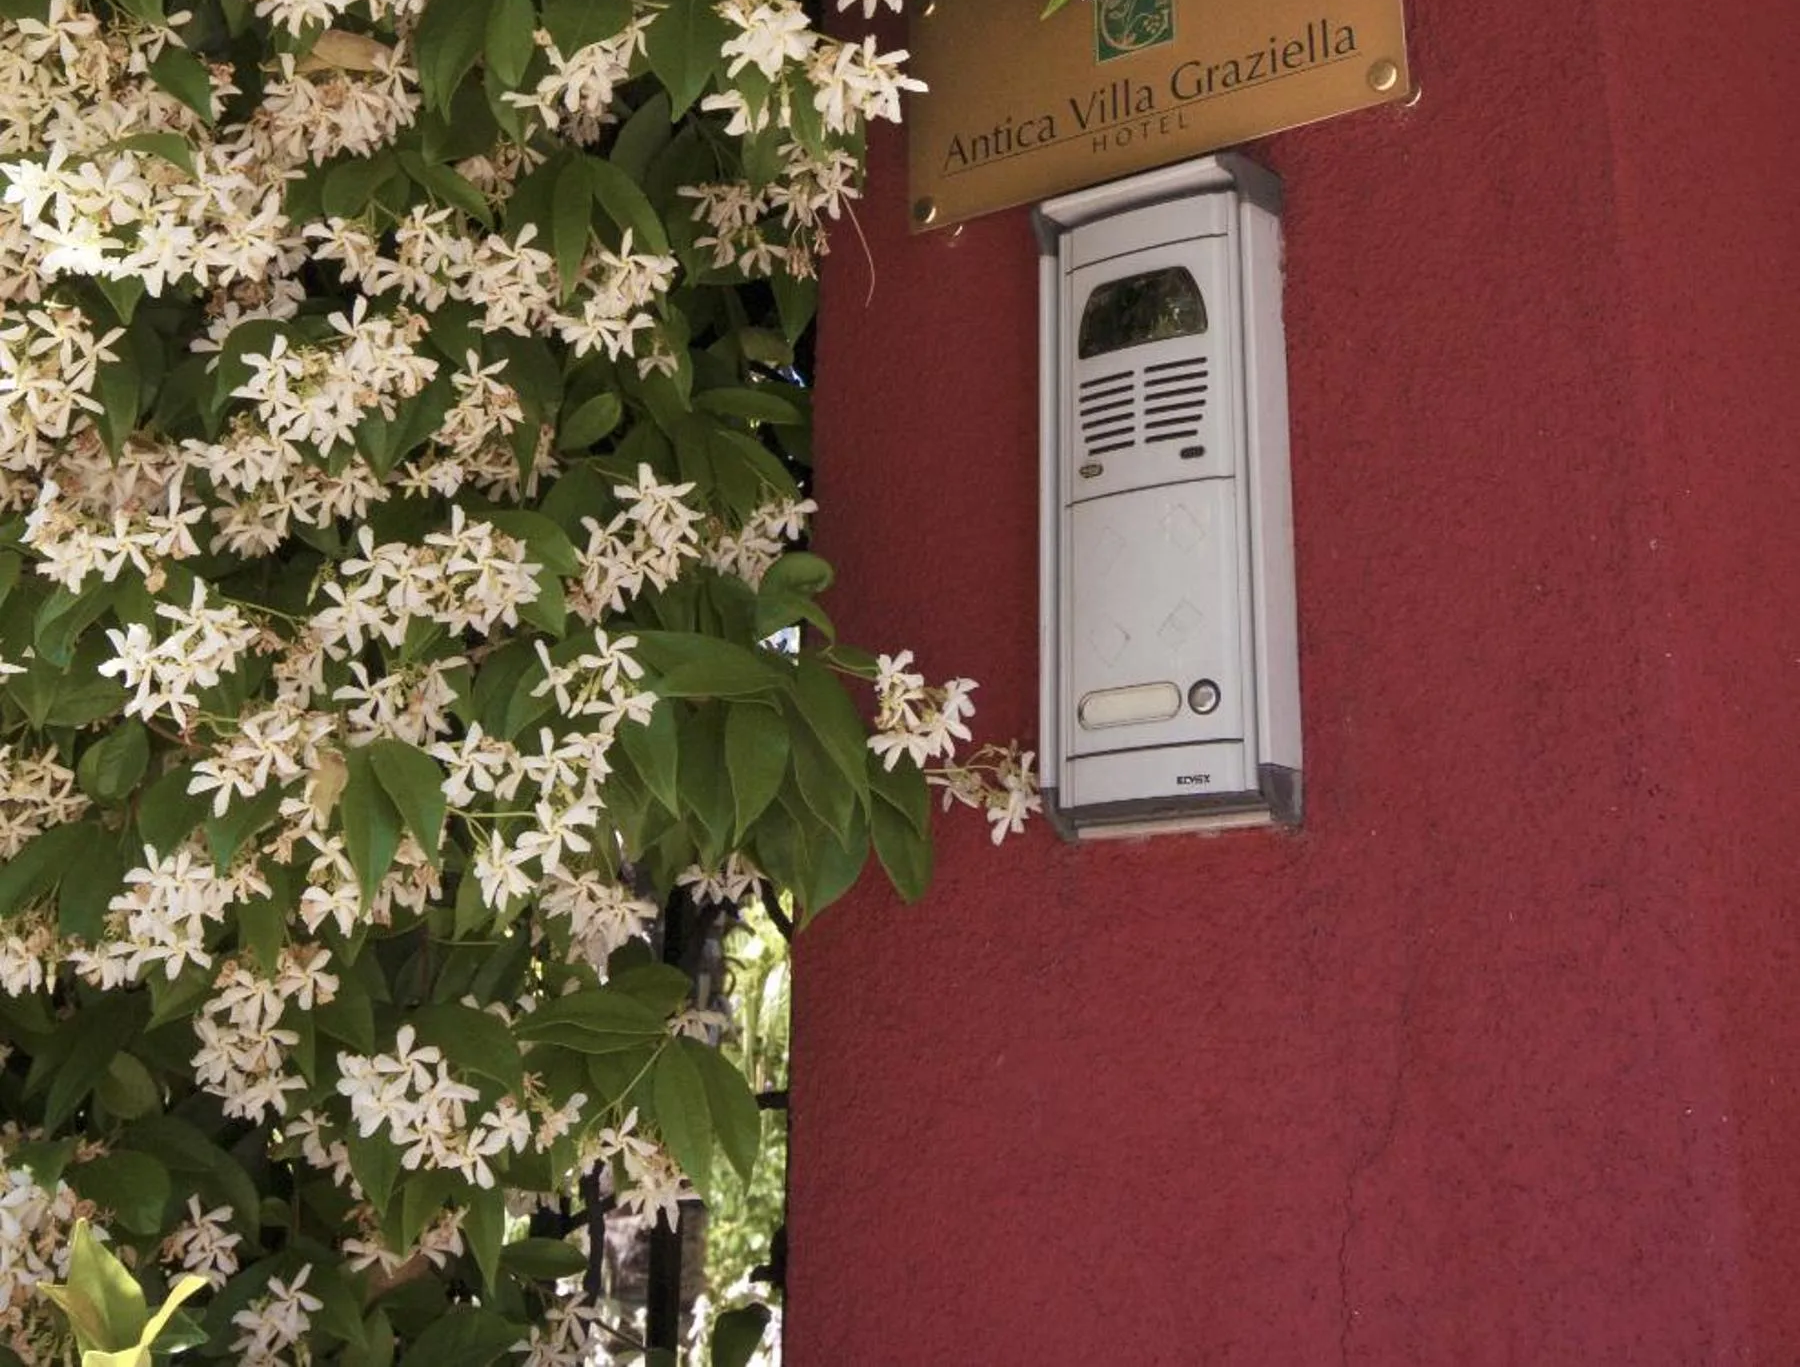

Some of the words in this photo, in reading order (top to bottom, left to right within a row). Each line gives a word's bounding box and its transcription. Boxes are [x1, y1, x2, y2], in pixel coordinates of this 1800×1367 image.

[943, 114, 1057, 171] Antica
[1069, 78, 1155, 130] Villa
[1169, 18, 1357, 101] Graziella
[1092, 112, 1190, 153] HOTEL
